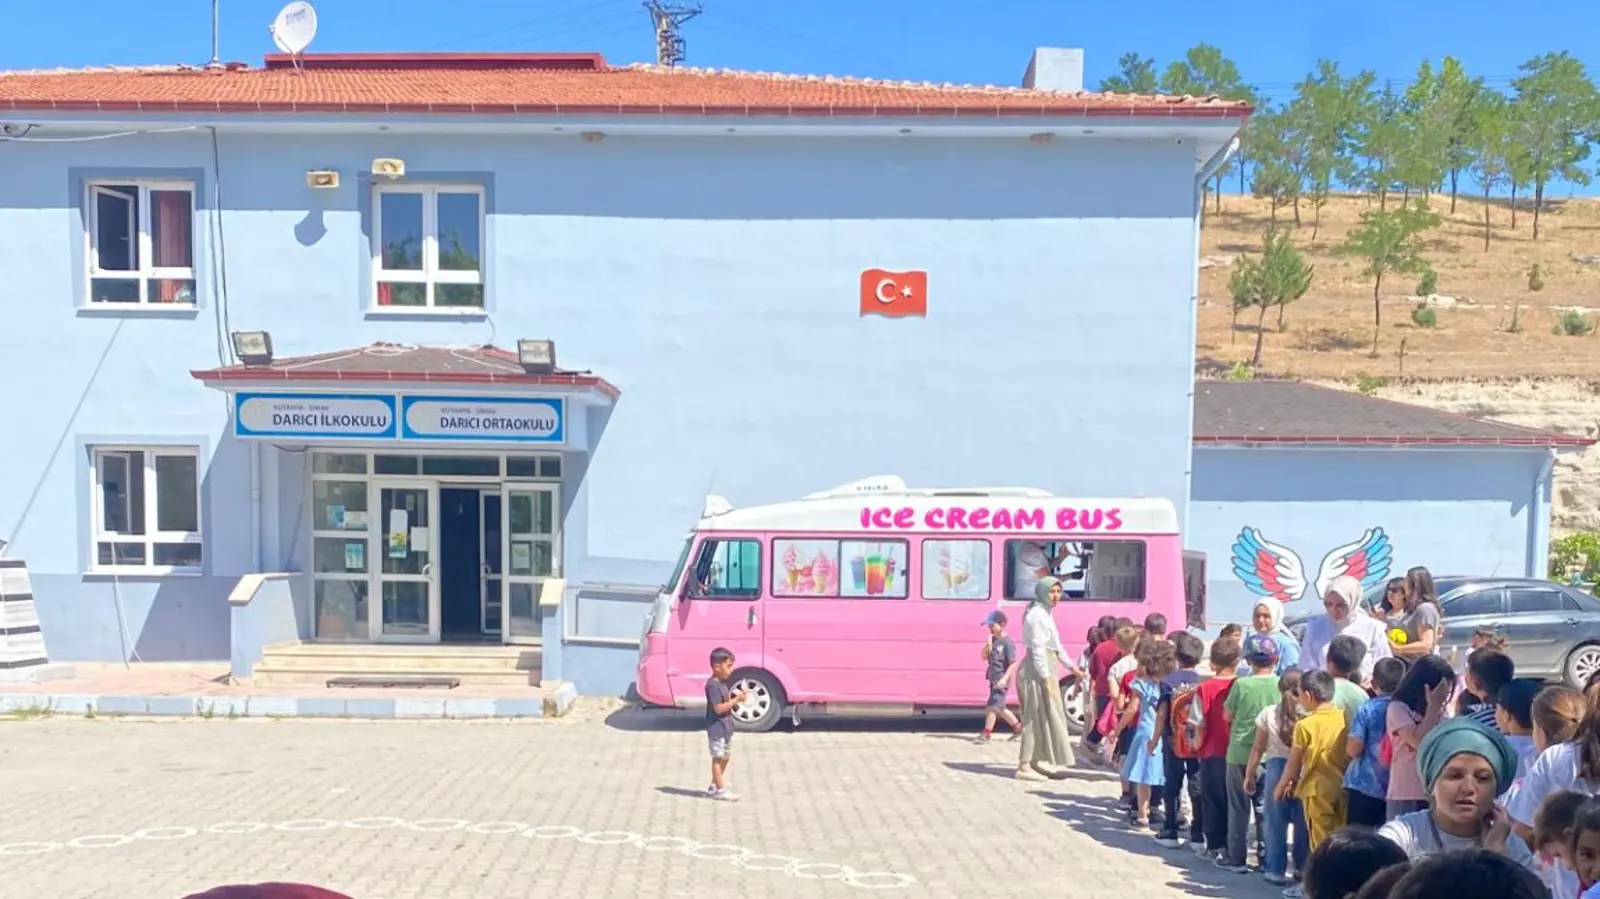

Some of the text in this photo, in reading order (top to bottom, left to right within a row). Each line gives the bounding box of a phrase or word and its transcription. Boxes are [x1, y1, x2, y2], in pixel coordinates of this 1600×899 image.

[272, 413, 387, 427] DARICI İLKOKULU
[440, 416, 555, 431] DARICI ORTAOKULU
[860, 507, 1123, 530] ICE CREAM BUS
